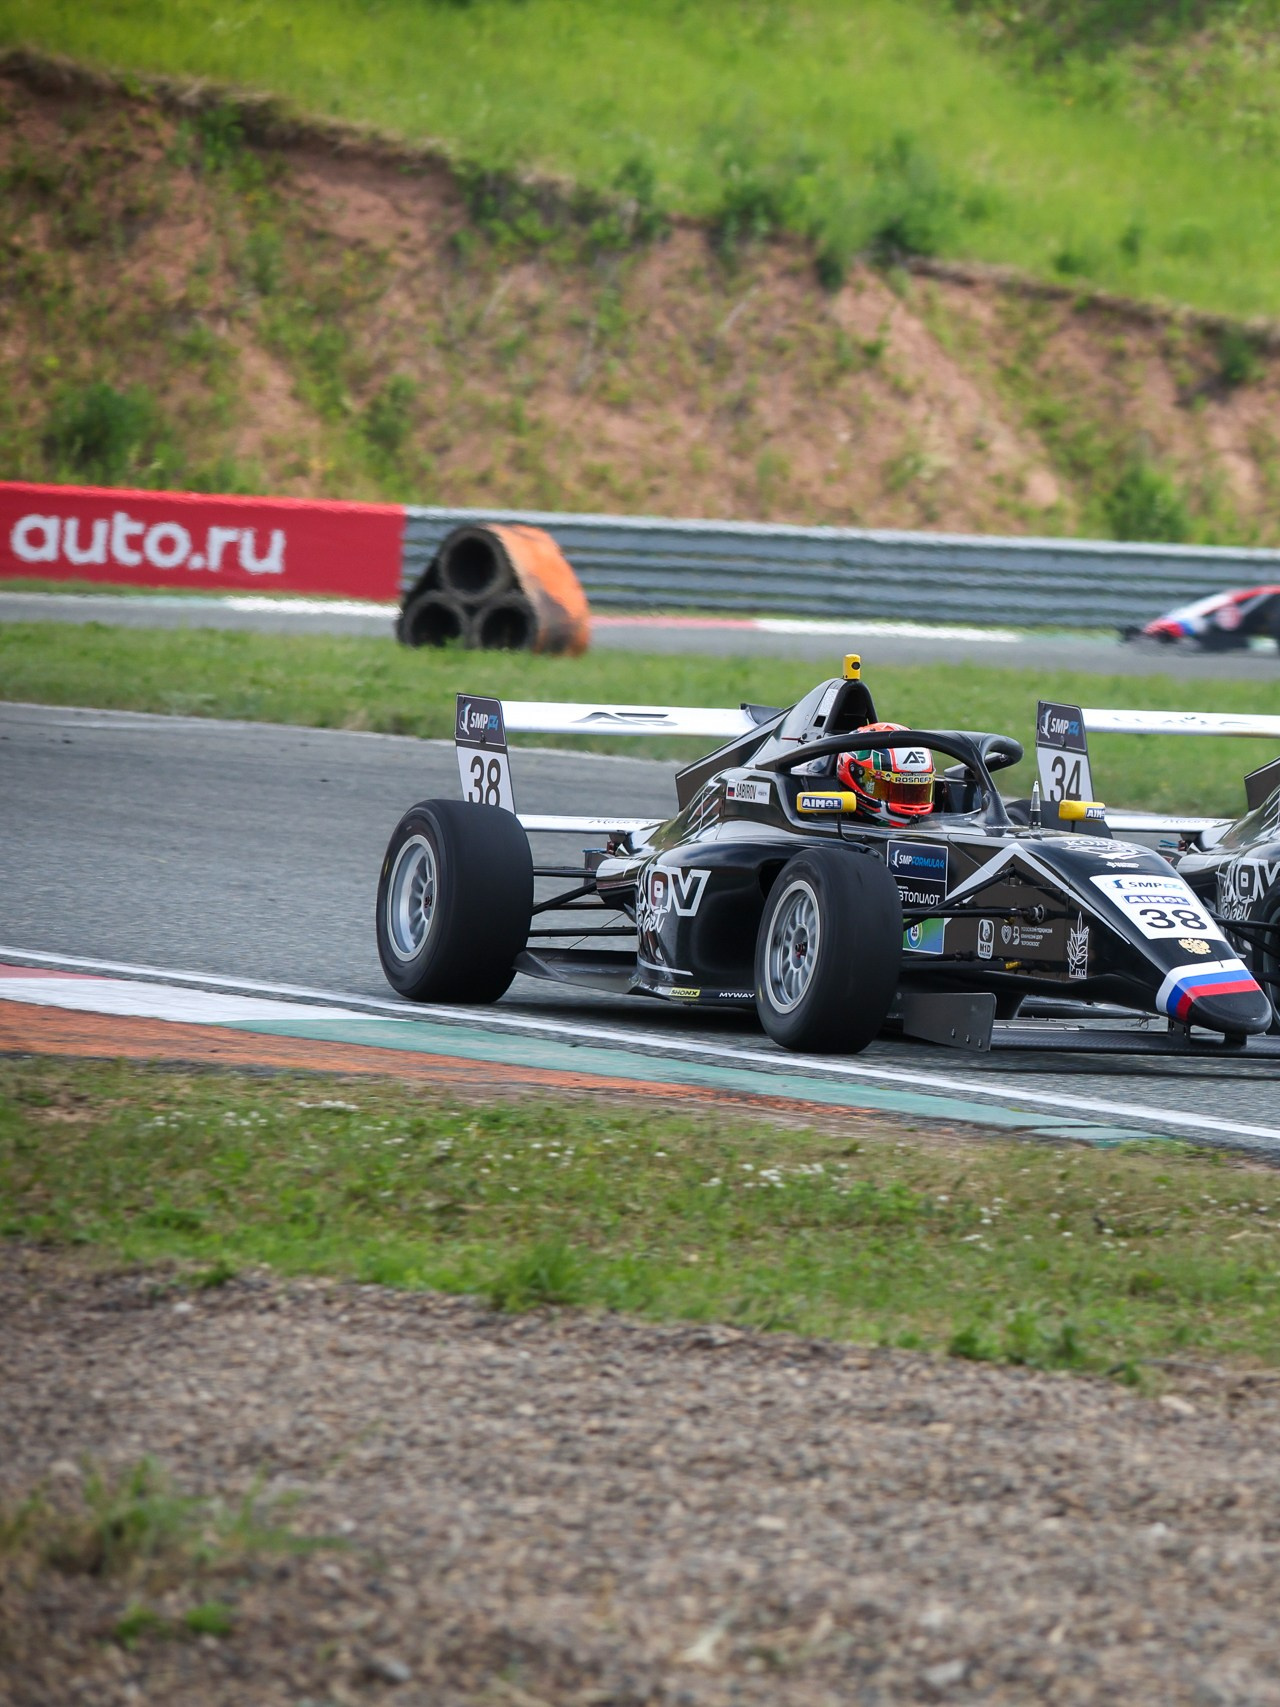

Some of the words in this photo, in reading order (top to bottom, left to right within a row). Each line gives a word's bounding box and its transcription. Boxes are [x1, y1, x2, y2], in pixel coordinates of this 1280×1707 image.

[10, 511, 286, 574] auto.ru
[468, 755, 501, 808] 38
[1050, 755, 1082, 803] 34
[736, 783, 757, 800] SABIROV
[802, 798, 840, 809] AIMOL
[899, 890, 940, 905] ВТОПИЛОТ
[1126, 895, 1189, 905] AIMOL
[1139, 908, 1208, 930] 38
[719, 991, 755, 999] MYWAY
